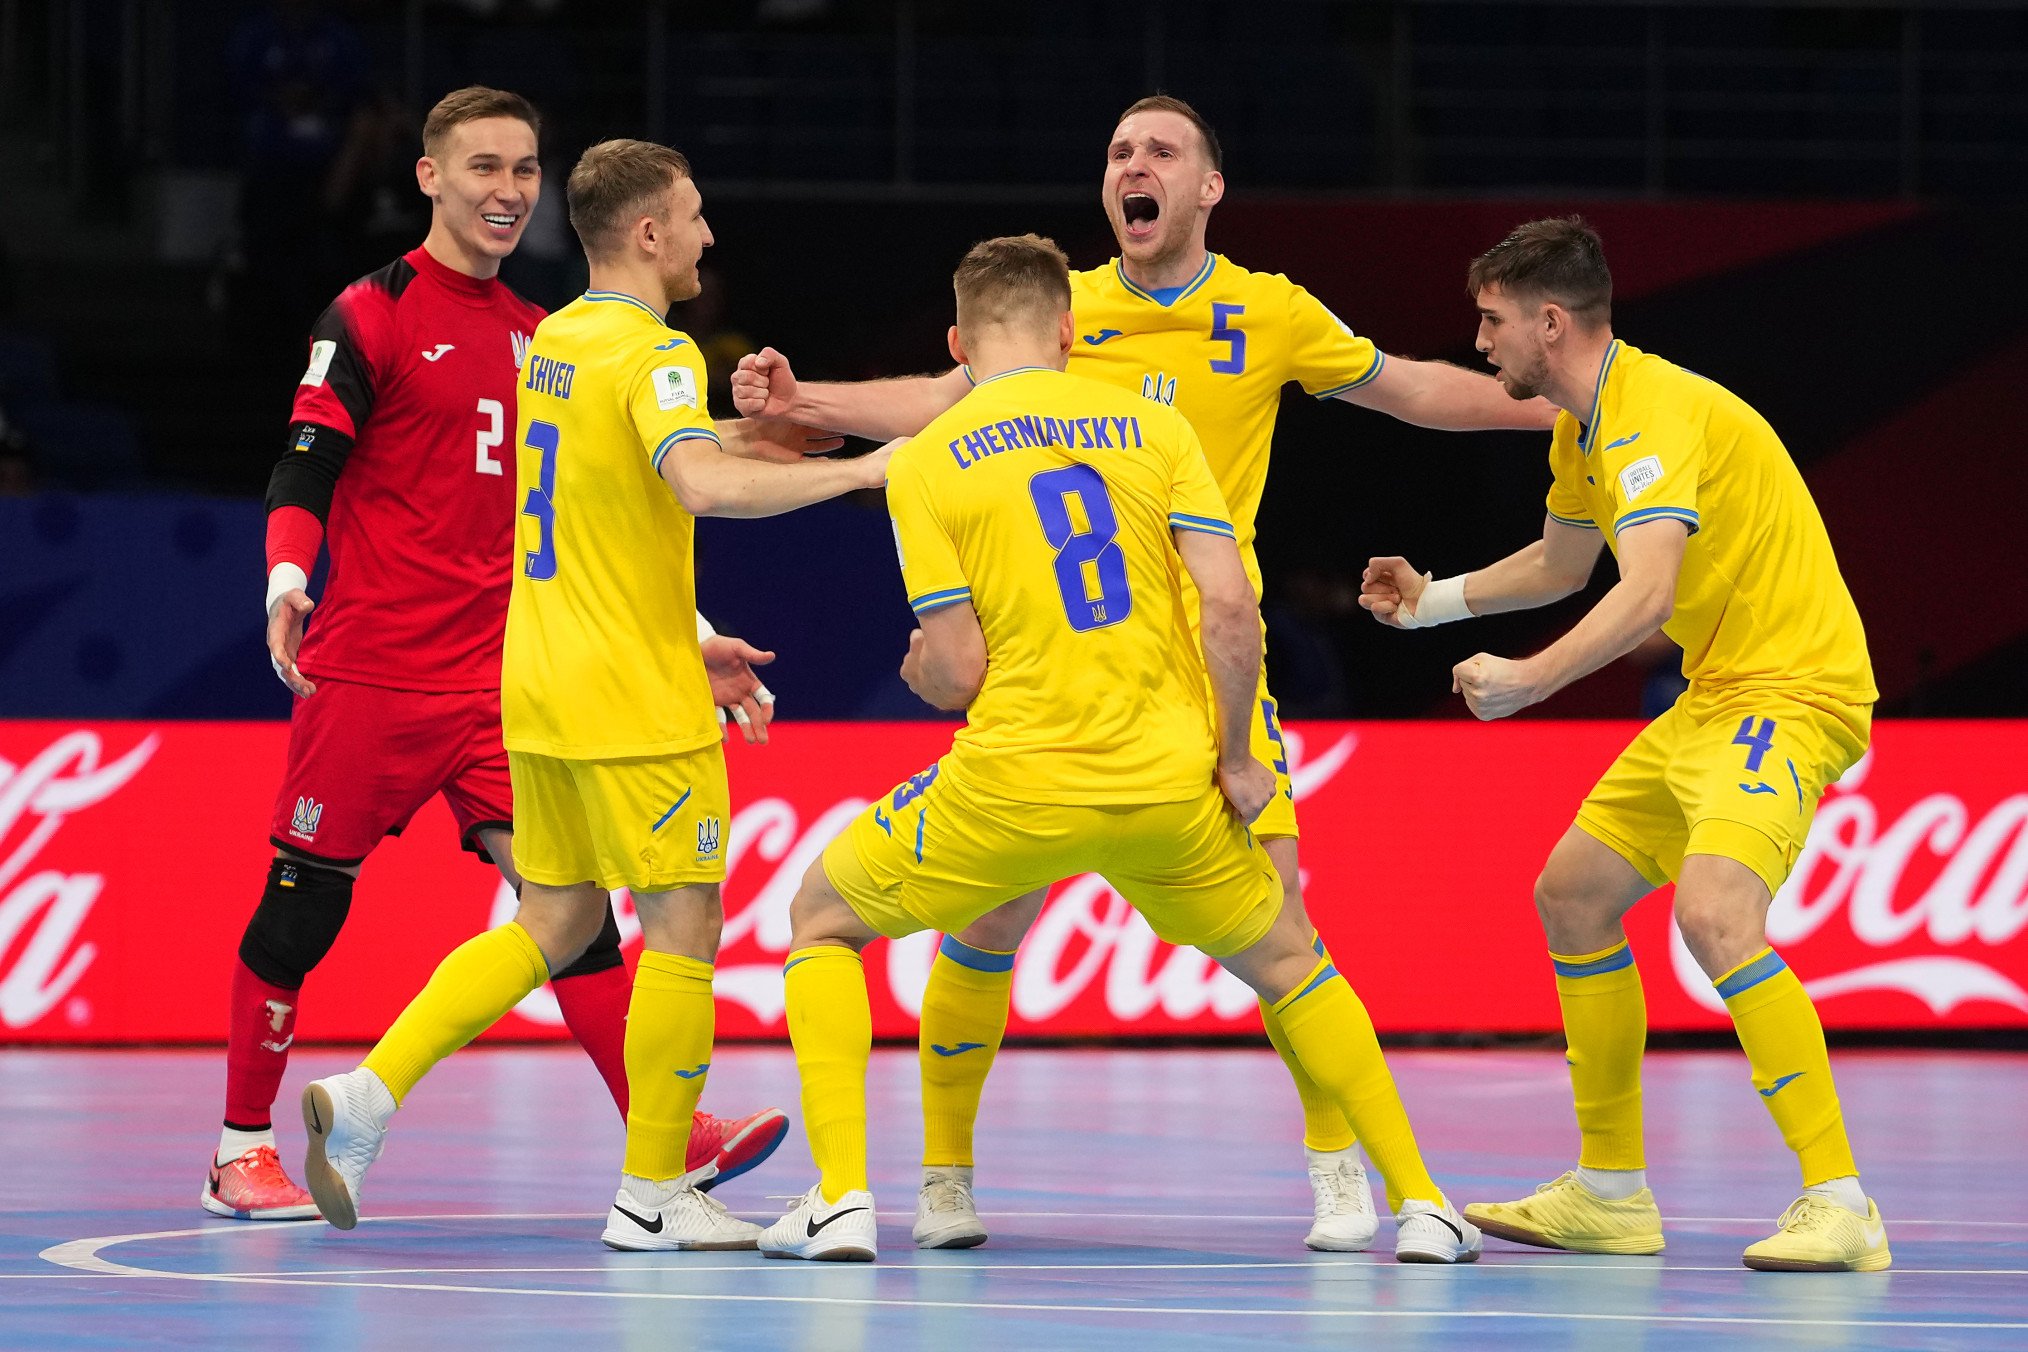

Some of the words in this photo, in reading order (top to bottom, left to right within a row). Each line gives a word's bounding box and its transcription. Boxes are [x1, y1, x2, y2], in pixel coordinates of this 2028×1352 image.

[1209, 302, 1246, 374] 5
[525, 354, 576, 400] SHVED
[475, 397, 504, 476] 2
[948, 414, 1143, 470] CHERNIAVSKYI
[523, 419, 560, 581] 3
[1629, 469, 1655, 486] UNITES
[1028, 462, 1132, 633] 8
[1261, 700, 1288, 775] 5
[1731, 715, 1777, 773] 4
[289, 829, 314, 842] UKRAINE
